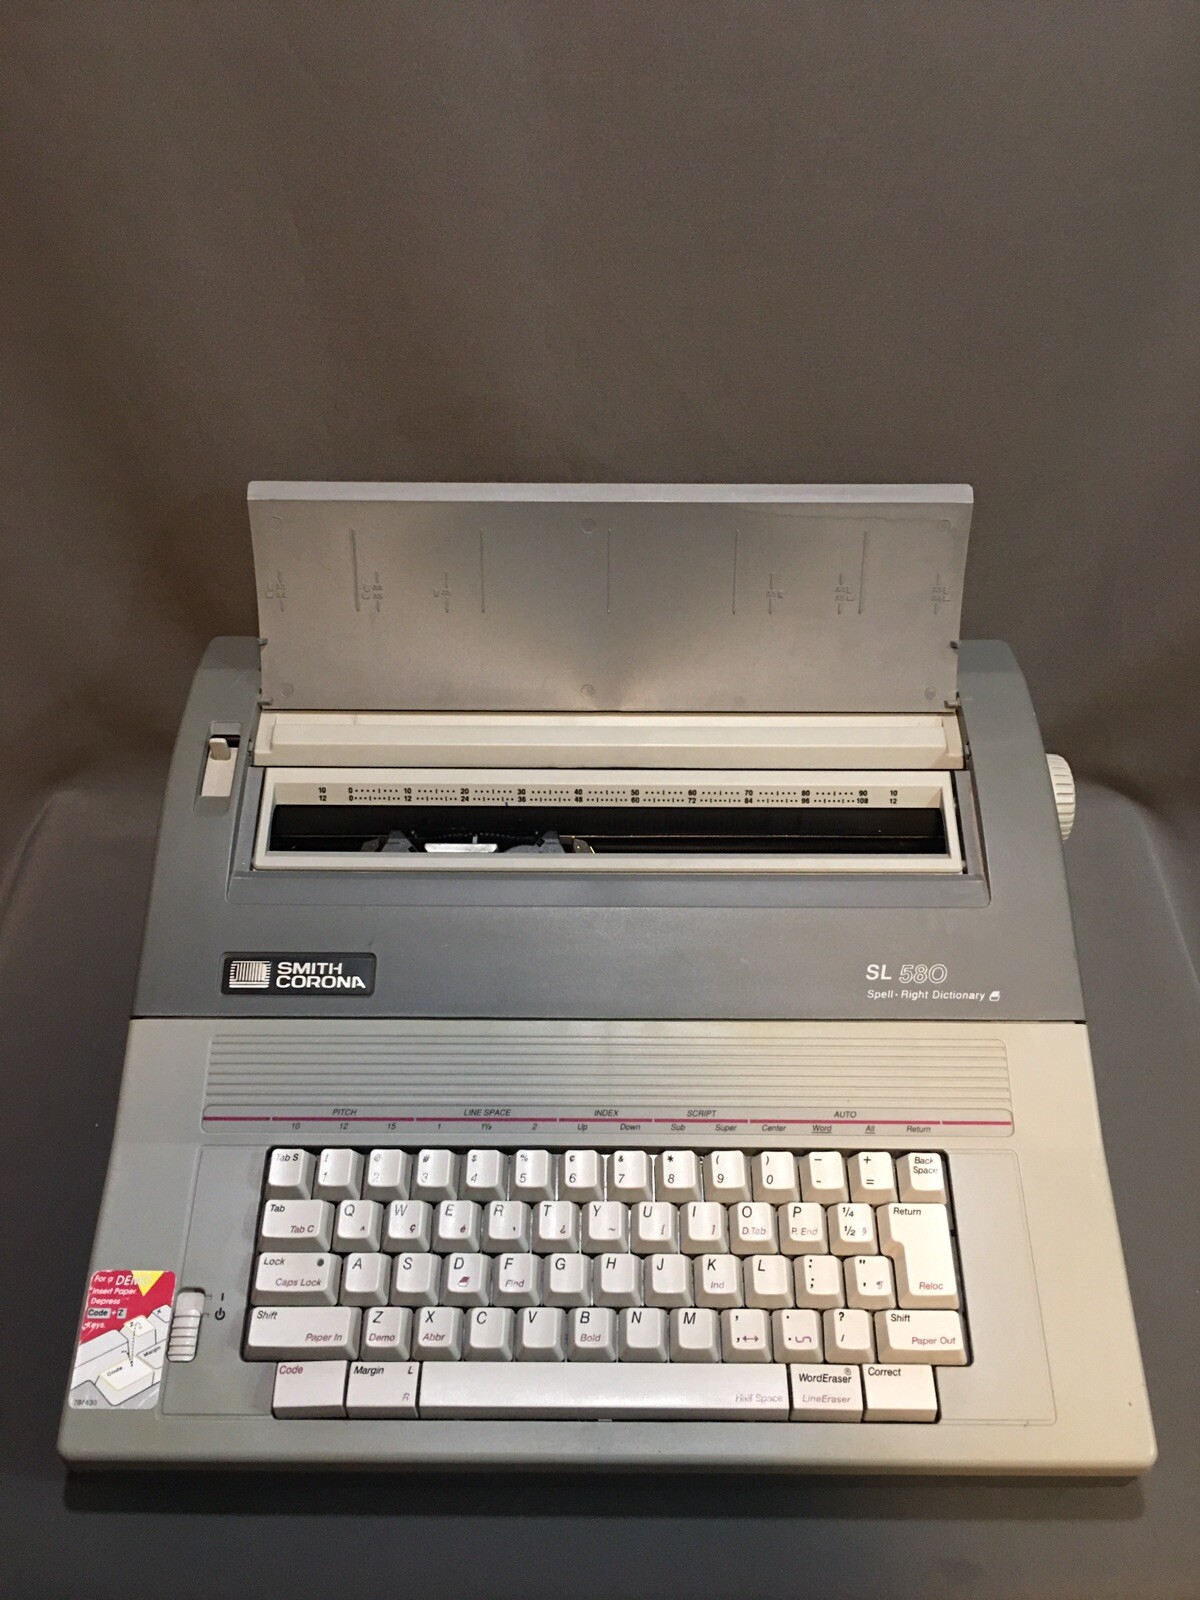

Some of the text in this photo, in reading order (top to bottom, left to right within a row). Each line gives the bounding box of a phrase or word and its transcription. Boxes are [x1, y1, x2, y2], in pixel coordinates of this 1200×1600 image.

[277, 962, 342, 974] SMITH
[866, 964, 948, 984] SL 580
[276, 975, 366, 988] CORONA
[932, 990, 986, 1001] Dictionary
[578, 1124, 588, 1132] Up
[715, 1124, 737, 1132] Super
[812, 1124, 832, 1134] Word
[866, 1124, 876, 1134] All
[292, 1154, 299, 1162] S
[914, 1157, 934, 1166] Back
[323, 1172, 328, 1182] 1
[372, 1173, 380, 1182] 2
[420, 1173, 428, 1182] 3
[470, 1173, 478, 1182] 4
[520, 1174, 526, 1182] 5
[569, 1174, 576, 1182] 6
[618, 1174, 625, 1184] 7
[668, 1174, 674, 1184] 8
[717, 1174, 724, 1183] 9
[270, 1204, 286, 1212] Tab
[344, 1204, 355, 1216] Q
[394, 1205, 408, 1216] W
[446, 1204, 454, 1216] E
[494, 1204, 504, 1216] R
[544, 1204, 552, 1216] T
[594, 1204, 602, 1216] Y
[643, 1206, 652, 1218] U
[742, 1206, 752, 1218] O
[793, 1206, 802, 1218] P
[894, 1207, 922, 1216] Return
[291, 1224, 315, 1233] Tab C
[801, 1227, 818, 1236] End
[264, 1258, 285, 1266] Lock
[352, 1258, 362, 1269] A
[403, 1258, 413, 1269] S
[454, 1258, 464, 1269] D
[505, 1258, 514, 1270] F
[556, 1258, 566, 1270] G
[606, 1258, 616, 1269] H
[656, 1258, 664, 1270] J
[708, 1259, 716, 1270] K
[758, 1260, 766, 1272] L
[276, 1278, 322, 1288] Caps Lock
[920, 1282, 944, 1290] Reloc
[257, 1312, 277, 1320] Shift
[373, 1312, 383, 1323] Z
[426, 1312, 434, 1323] X
[477, 1312, 487, 1324] C
[529, 1312, 538, 1323] V
[580, 1312, 590, 1323] B
[632, 1312, 642, 1323] N
[684, 1312, 696, 1324] M
[839, 1312, 844, 1322] ?
[891, 1313, 910, 1322] Shift
[306, 1334, 331, 1342] Paper
[422, 1333, 445, 1342] Abbr
[580, 1334, 601, 1342] Bold
[912, 1336, 956, 1346] Paper Out
[280, 1366, 303, 1374] Code
[354, 1366, 384, 1376] Margin
[868, 1367, 901, 1376] Correct
[402, 1393, 410, 1401] R
[802, 1395, 850, 1403] LineEraser
